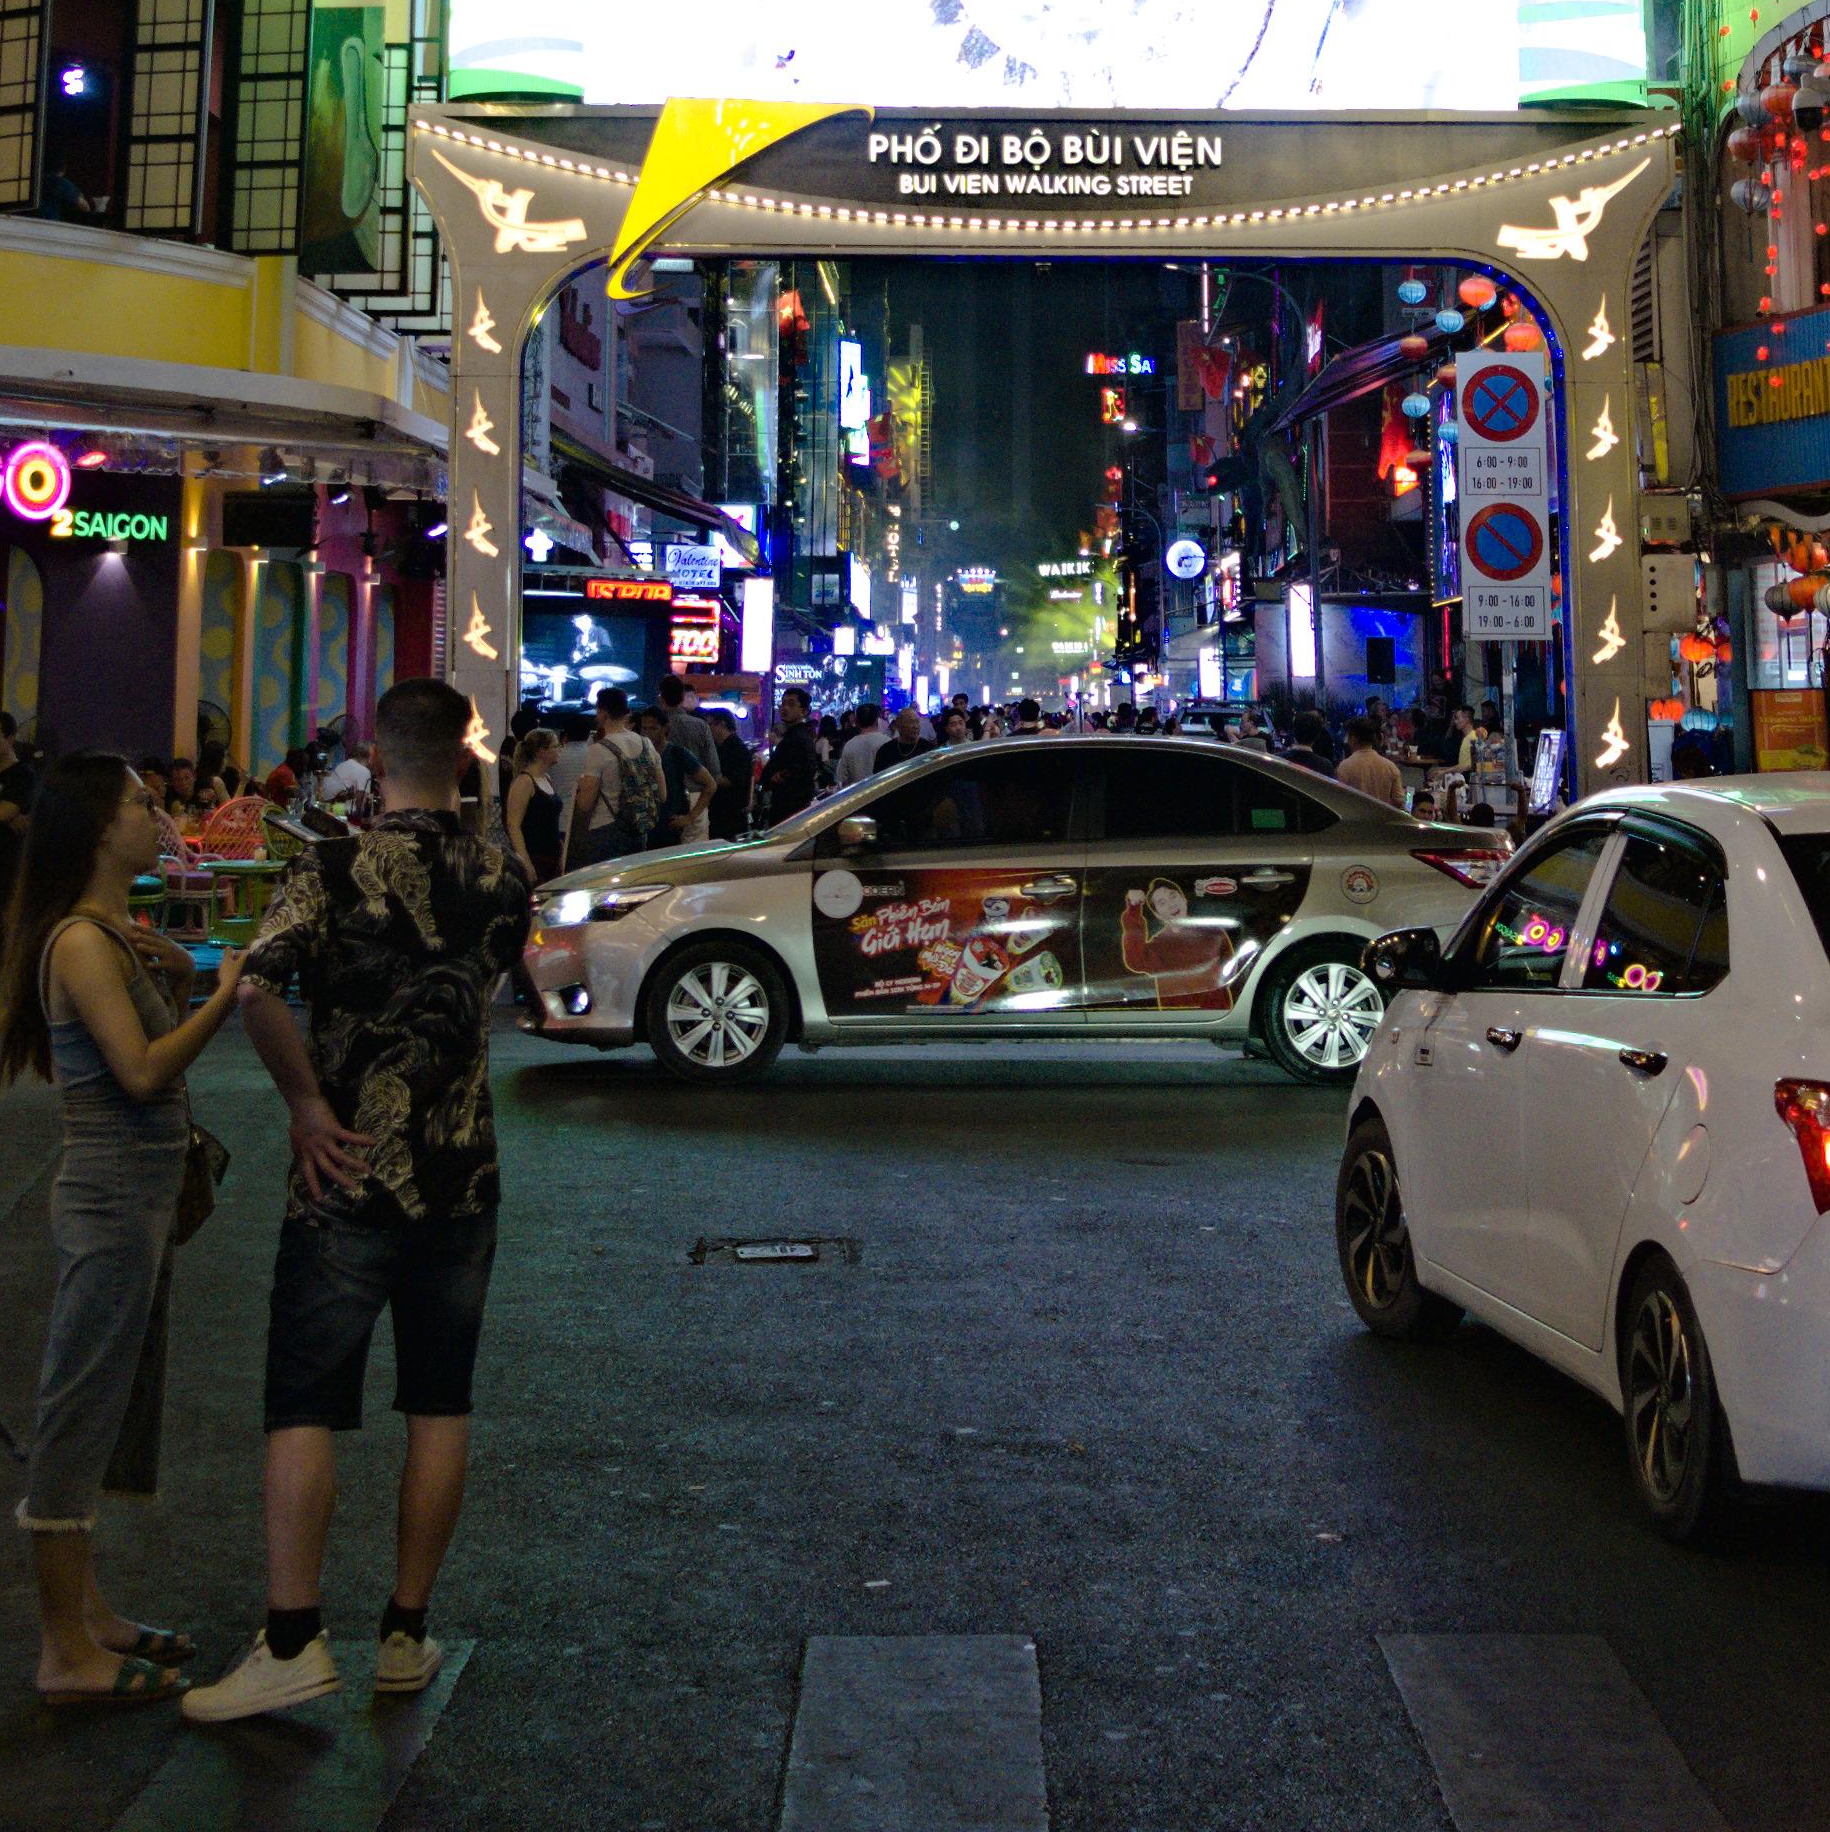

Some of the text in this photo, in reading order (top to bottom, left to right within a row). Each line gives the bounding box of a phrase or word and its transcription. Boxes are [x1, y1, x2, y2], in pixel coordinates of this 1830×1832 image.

[869, 123, 1223, 172] PHỐ ĐI BỘ BÙI VIỆN
[899, 173, 1194, 196] BUI VIEN WALKING STREET
[1476, 456, 1529, 469] 6:00 9:00
[1472, 476, 1533, 489] 16:00 19:00
[667, 546, 719, 568] Valentine
[1478, 594, 1535, 607] 9:00 16:00
[1478, 615, 1535, 628] 19:00 6:00
[861, 926, 902, 955] Giới
